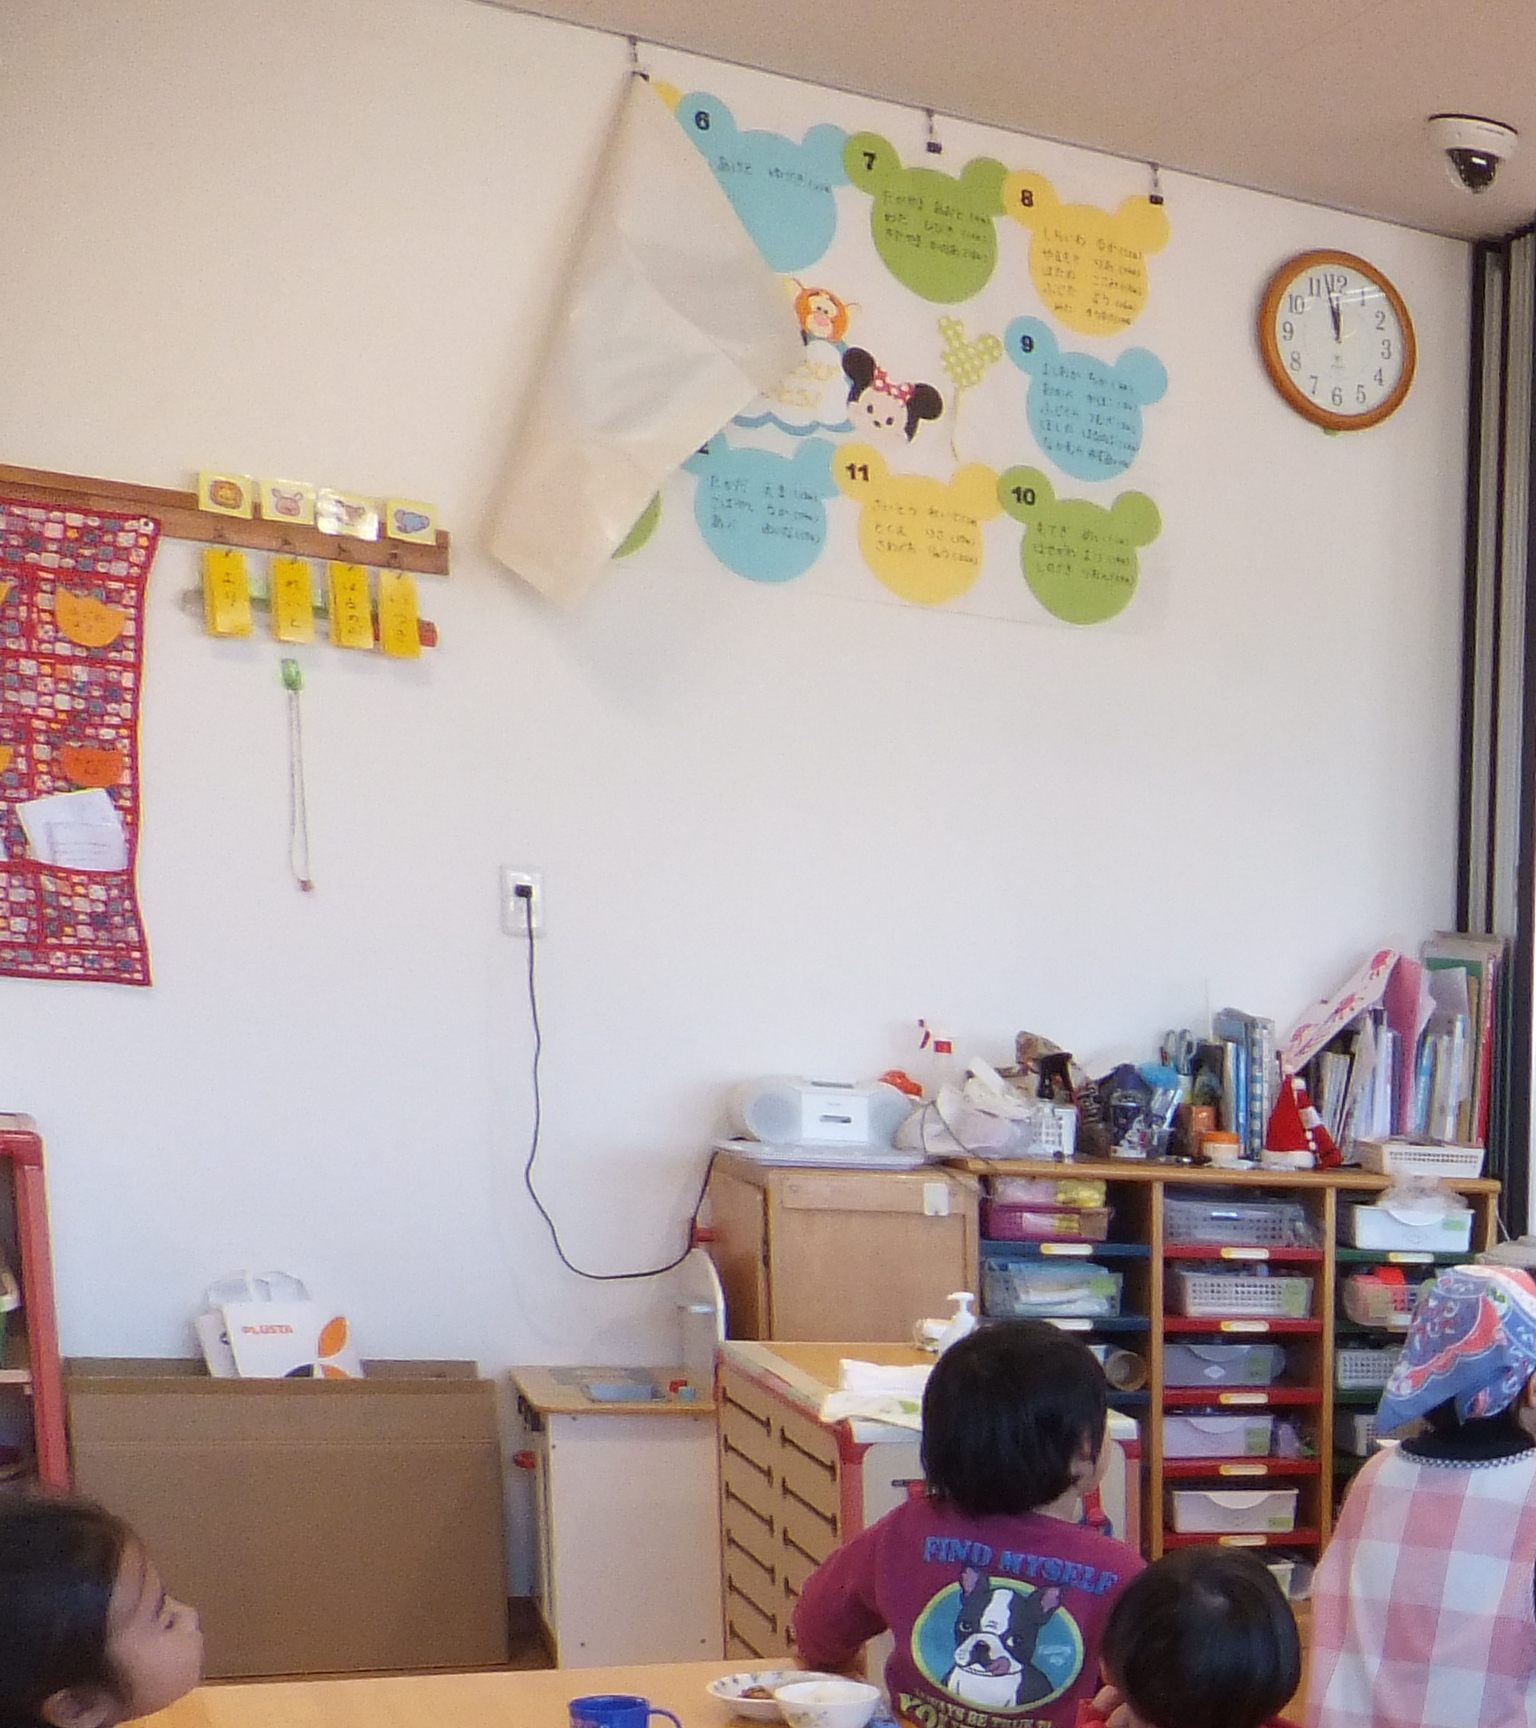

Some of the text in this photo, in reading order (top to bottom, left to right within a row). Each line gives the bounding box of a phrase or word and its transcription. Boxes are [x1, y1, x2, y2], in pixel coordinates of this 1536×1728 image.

[694, 110, 711, 132] 6
[862, 150, 878, 171] 7
[1020, 189, 1035, 208] 8
[1308, 277, 1322, 297] 11
[1288, 294, 1305, 314] 10
[1375, 311, 1386, 331] 2
[1282, 322, 1294, 341] 9
[1019, 334, 1035, 354] 9
[1381, 339, 1391, 359] 3
[1290, 351, 1302, 372] 8
[1310, 376, 1319, 395] 7
[1374, 368, 1384, 386] 4
[1331, 387, 1342, 406] 6
[1356, 385, 1366, 404] 5
[845, 462, 870, 483] 11
[1011, 485, 1037, 507] 10
[923, 1536, 1118, 1595] FIND MYSELF
[967, 1711, 988, 1728] BE
